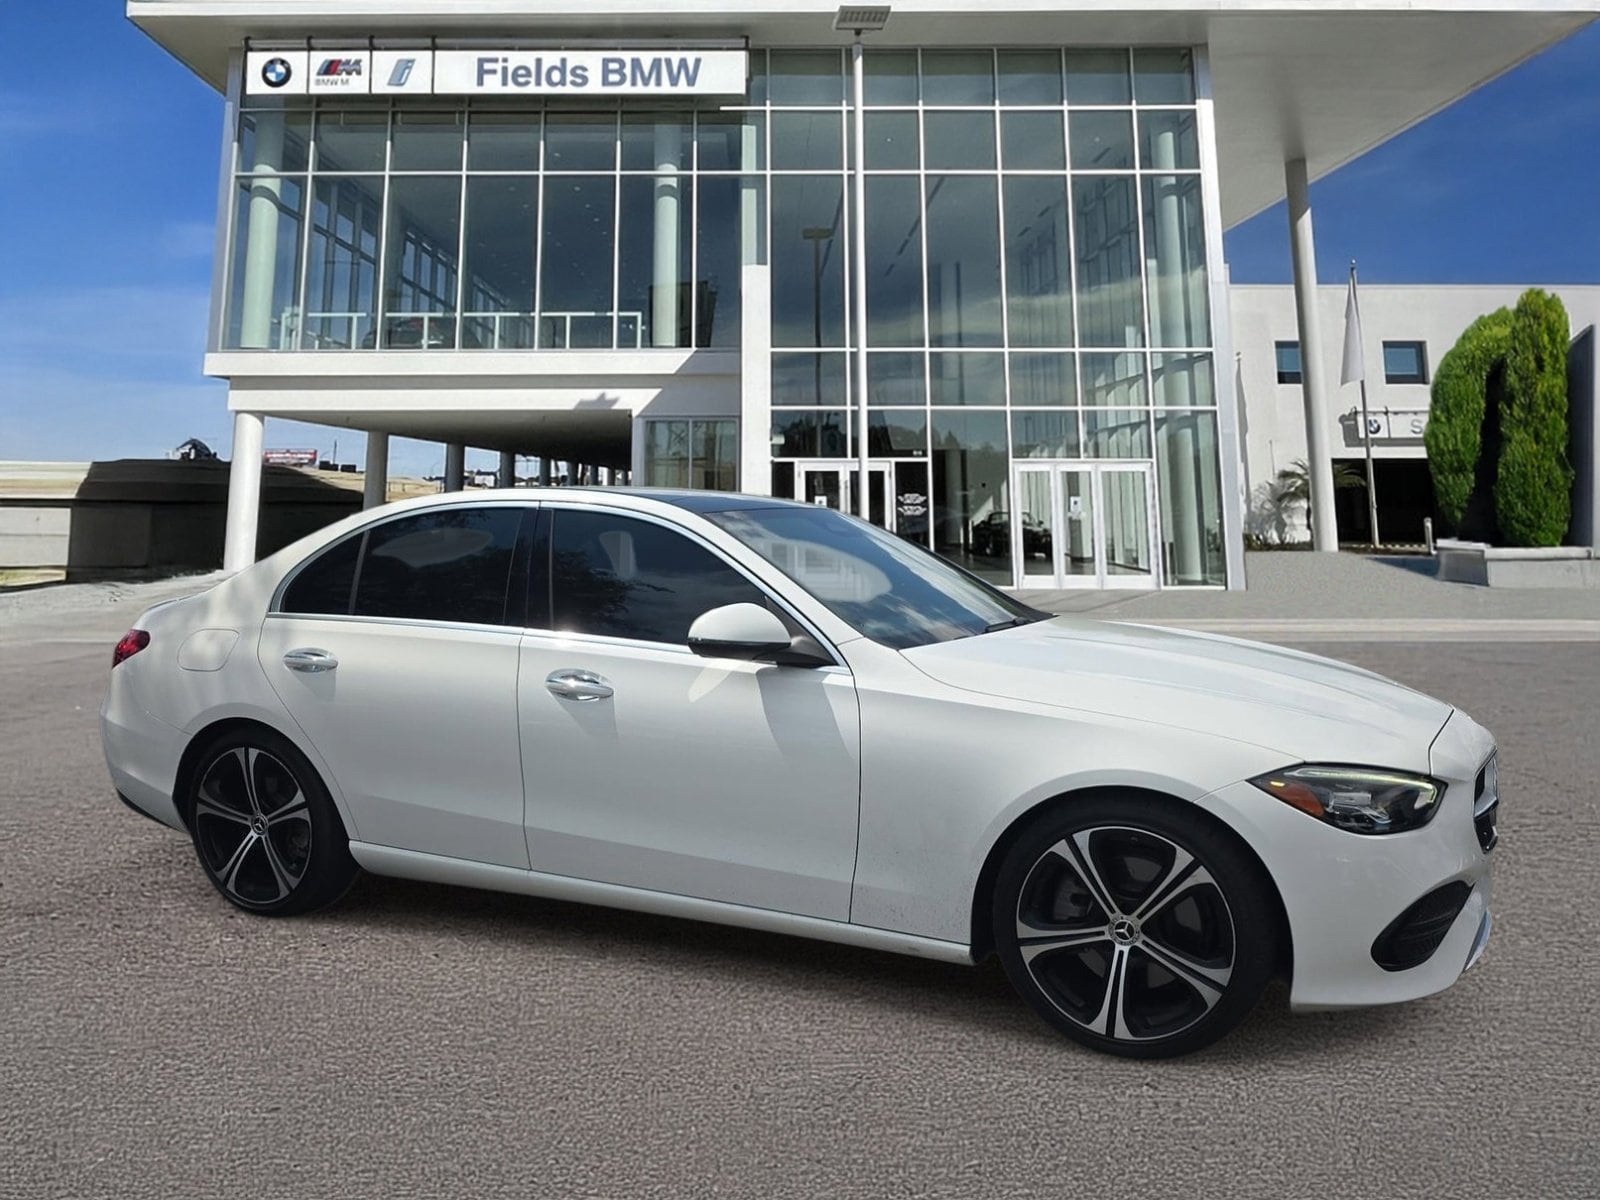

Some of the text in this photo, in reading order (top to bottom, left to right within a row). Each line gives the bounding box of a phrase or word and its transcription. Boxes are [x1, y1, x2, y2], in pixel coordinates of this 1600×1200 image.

[476, 57, 701, 87] Fields BMW
[315, 78, 338, 86] BMW
